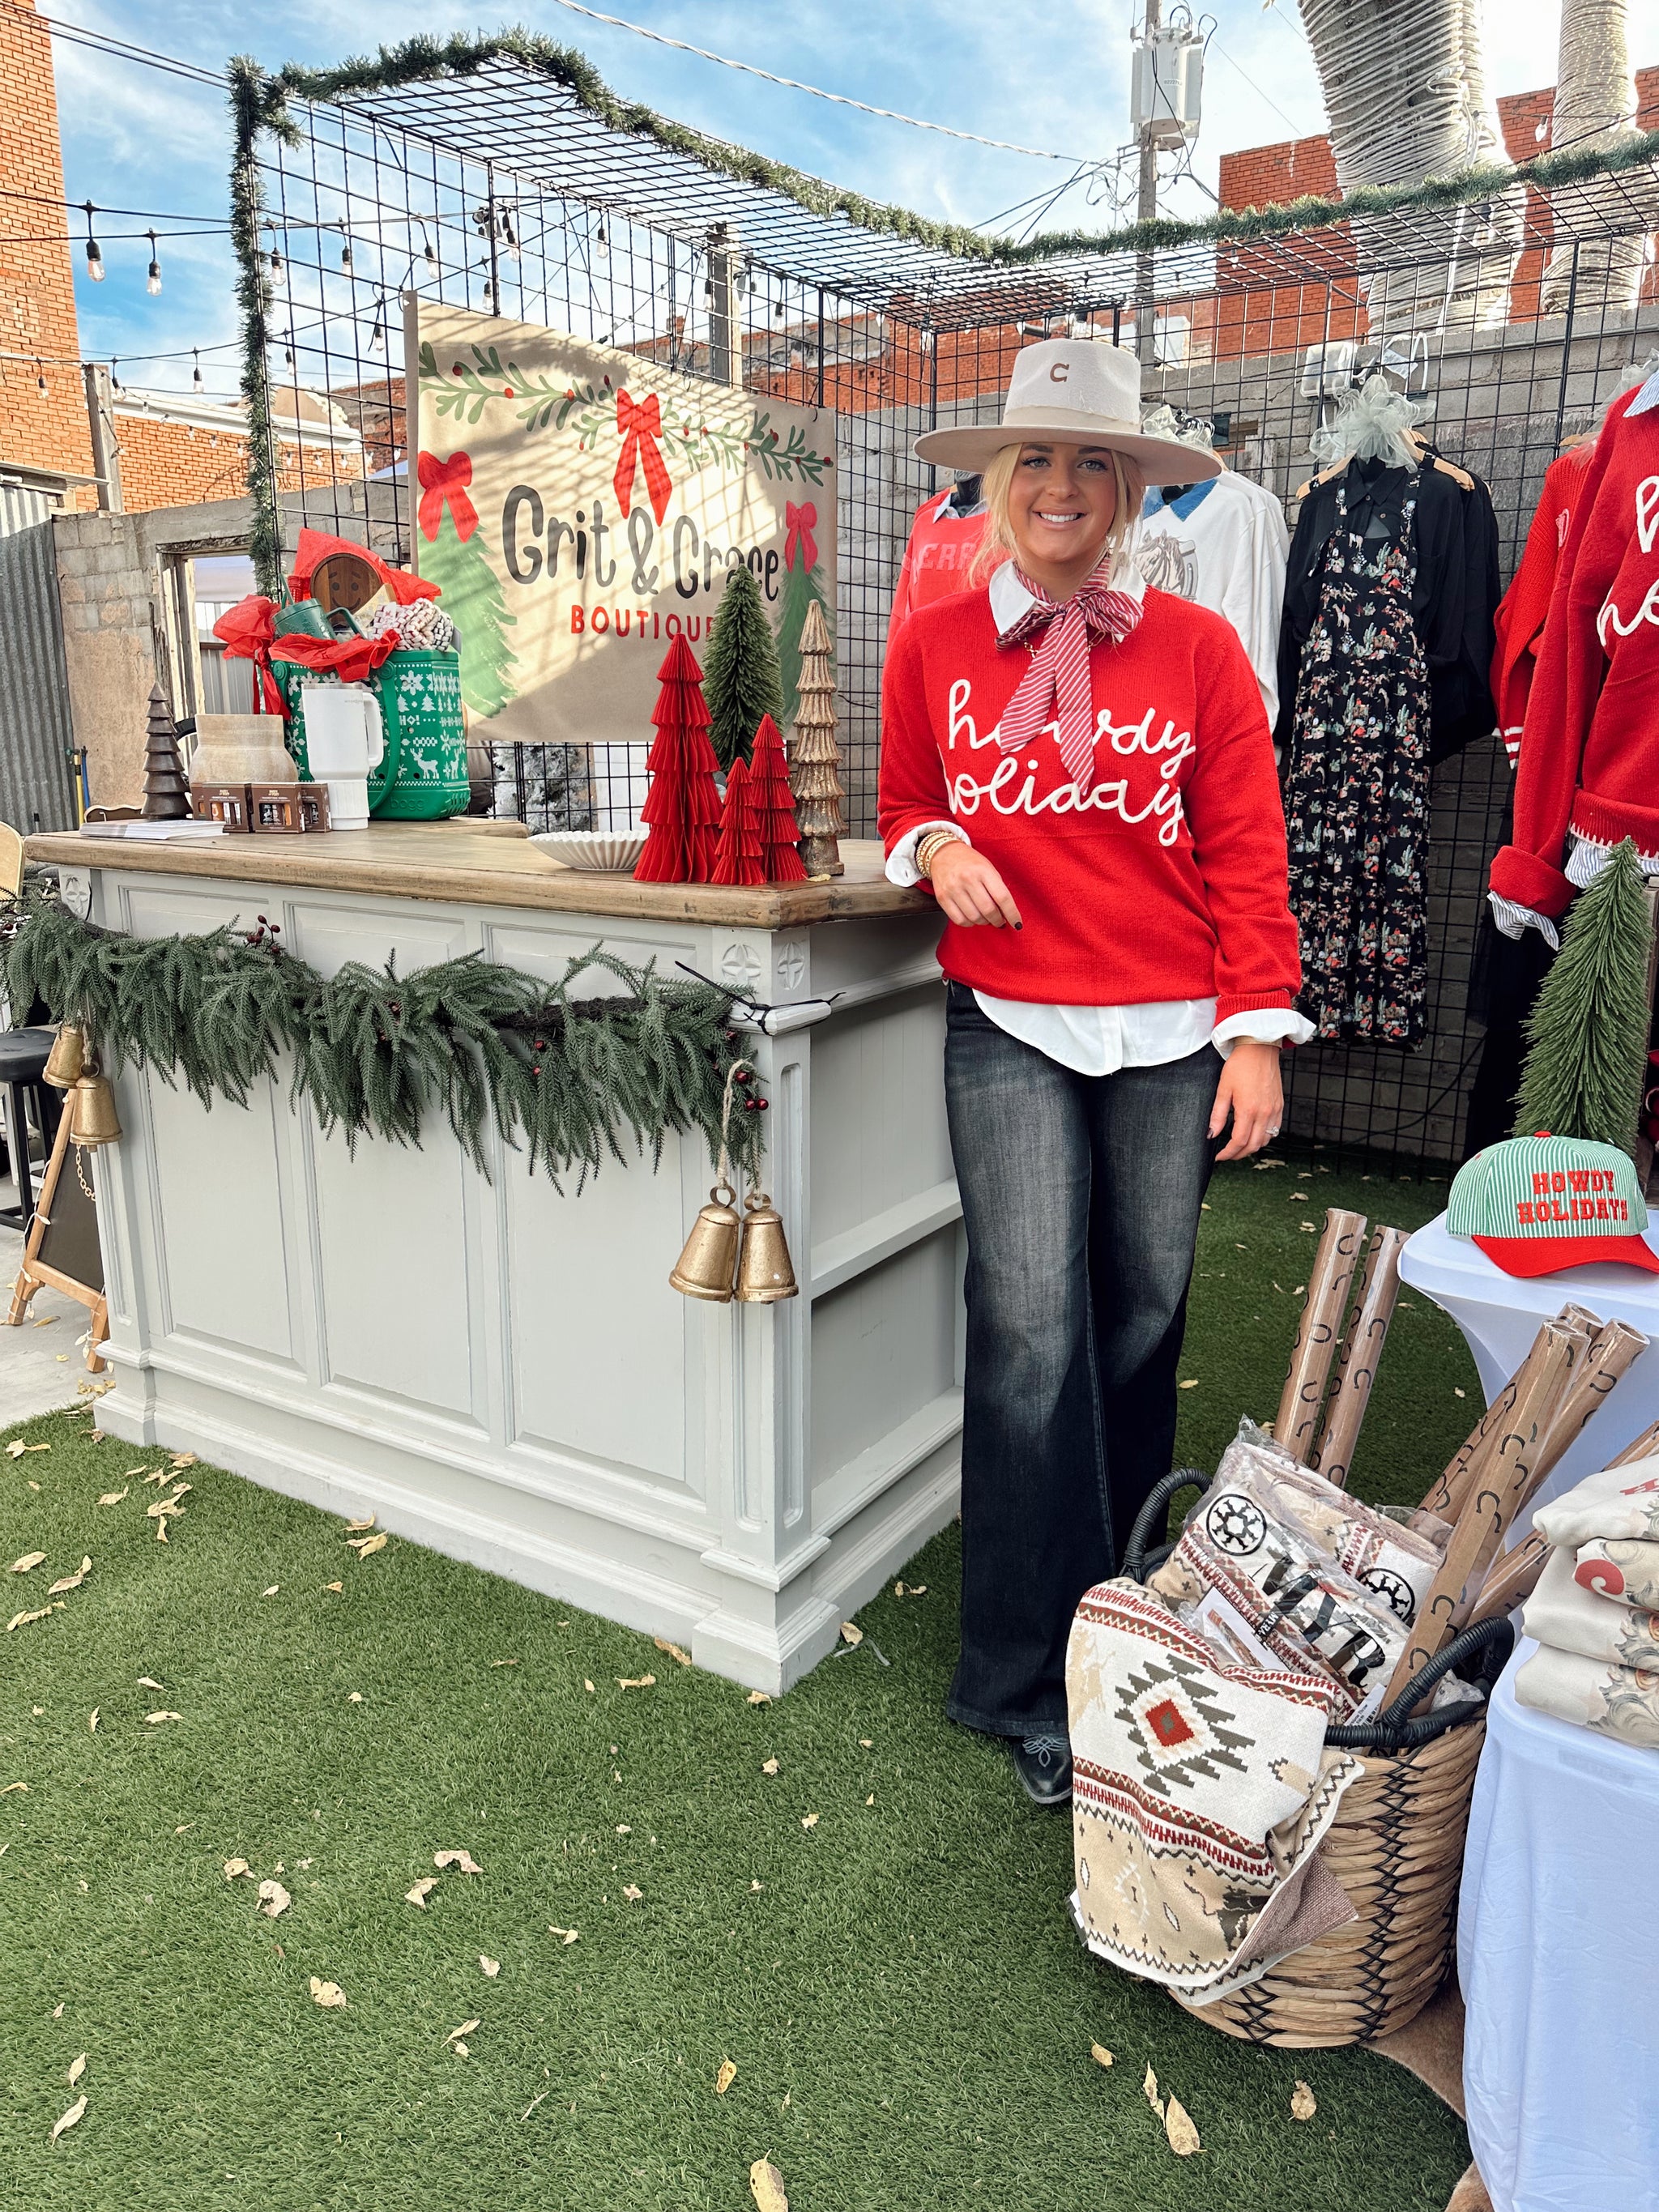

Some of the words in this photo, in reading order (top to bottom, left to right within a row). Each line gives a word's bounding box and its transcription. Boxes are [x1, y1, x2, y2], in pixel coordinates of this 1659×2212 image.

[502, 484, 616, 587] Grit
[628, 507, 659, 595] &
[389, 796, 425, 811] bogg
[942, 756, 1185, 846] oliday
[1532, 1170, 1614, 1195] HOWDY
[1517, 1198, 1628, 1224] HOLIDAYS
